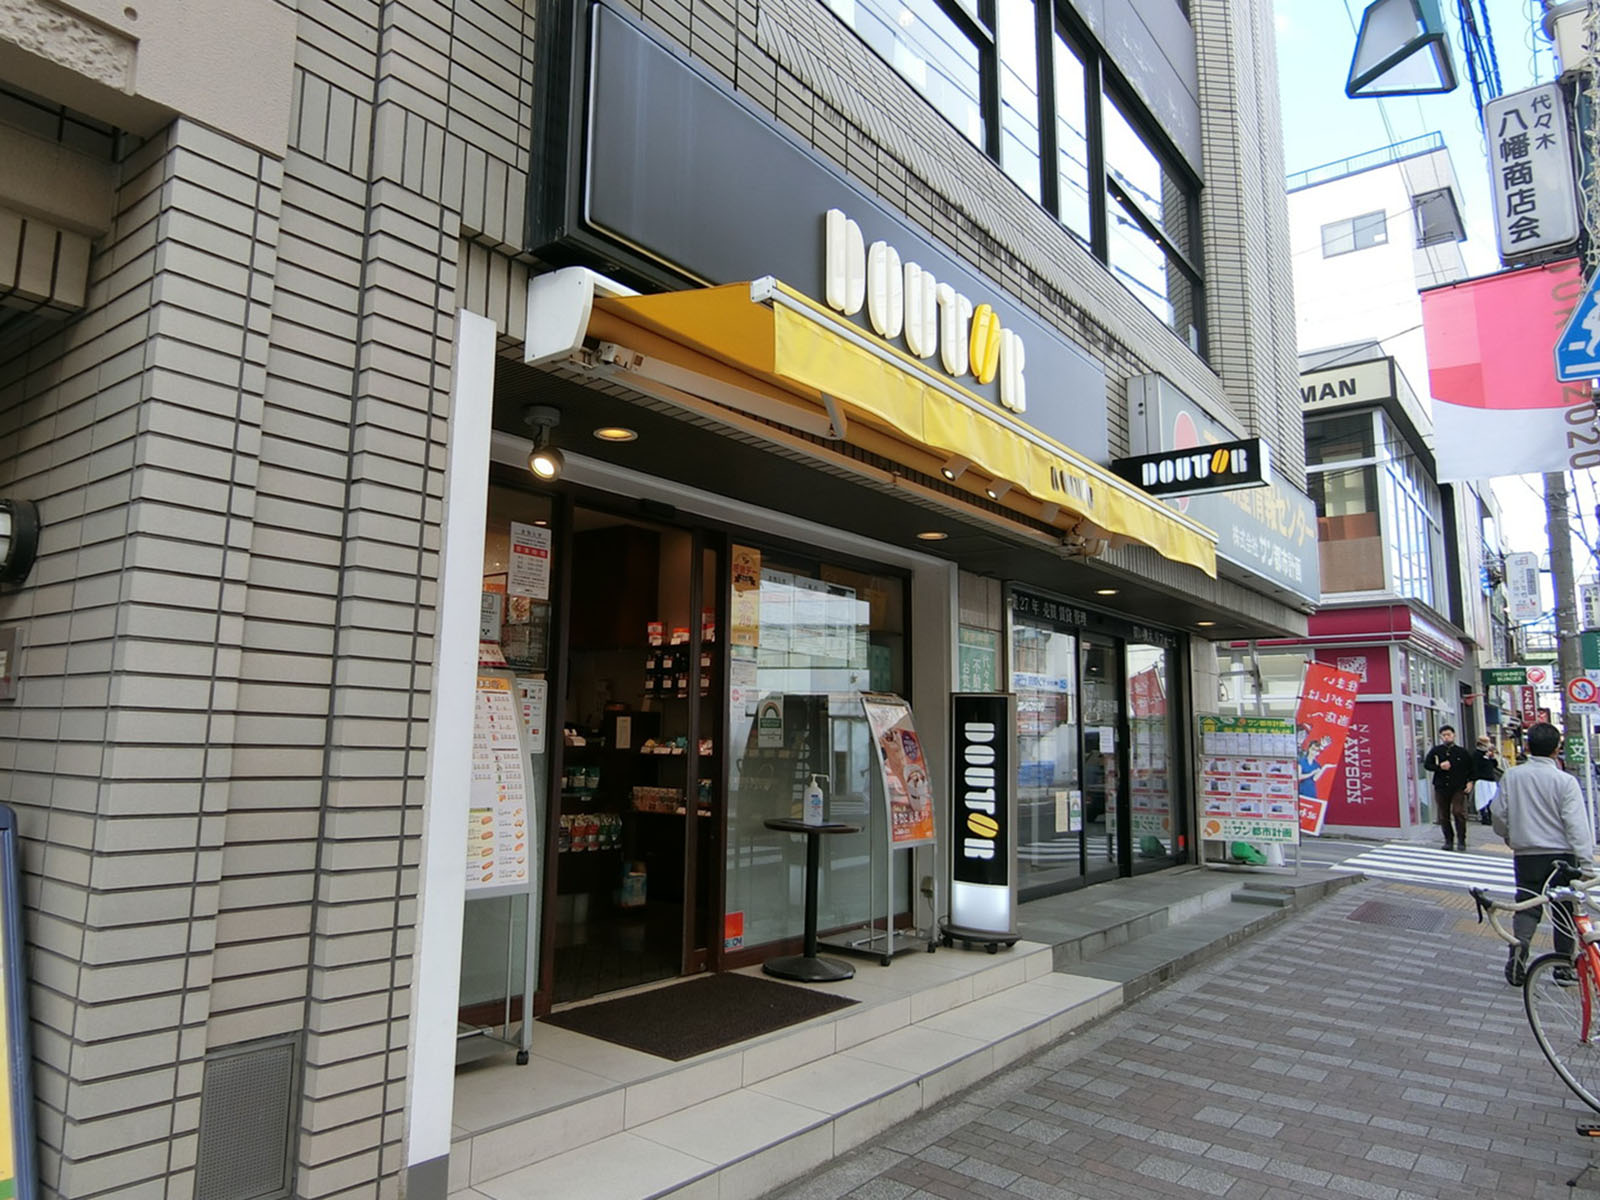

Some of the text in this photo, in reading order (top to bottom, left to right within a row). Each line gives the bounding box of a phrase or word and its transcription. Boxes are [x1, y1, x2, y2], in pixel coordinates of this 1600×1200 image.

[1531, 94, 1556, 150] 代々木
[1498, 108, 1541, 244] 八幡商店会
[826, 208, 1027, 414] DOUTOR
[1142, 449, 1248, 486] DOUTOR
[1524, 690, 1534, 717] とんかつ
[963, 722, 999, 860] DOUTOR
[1358, 724, 1373, 804] NATURAL
[1232, 825, 1292, 838] サン都市計画
